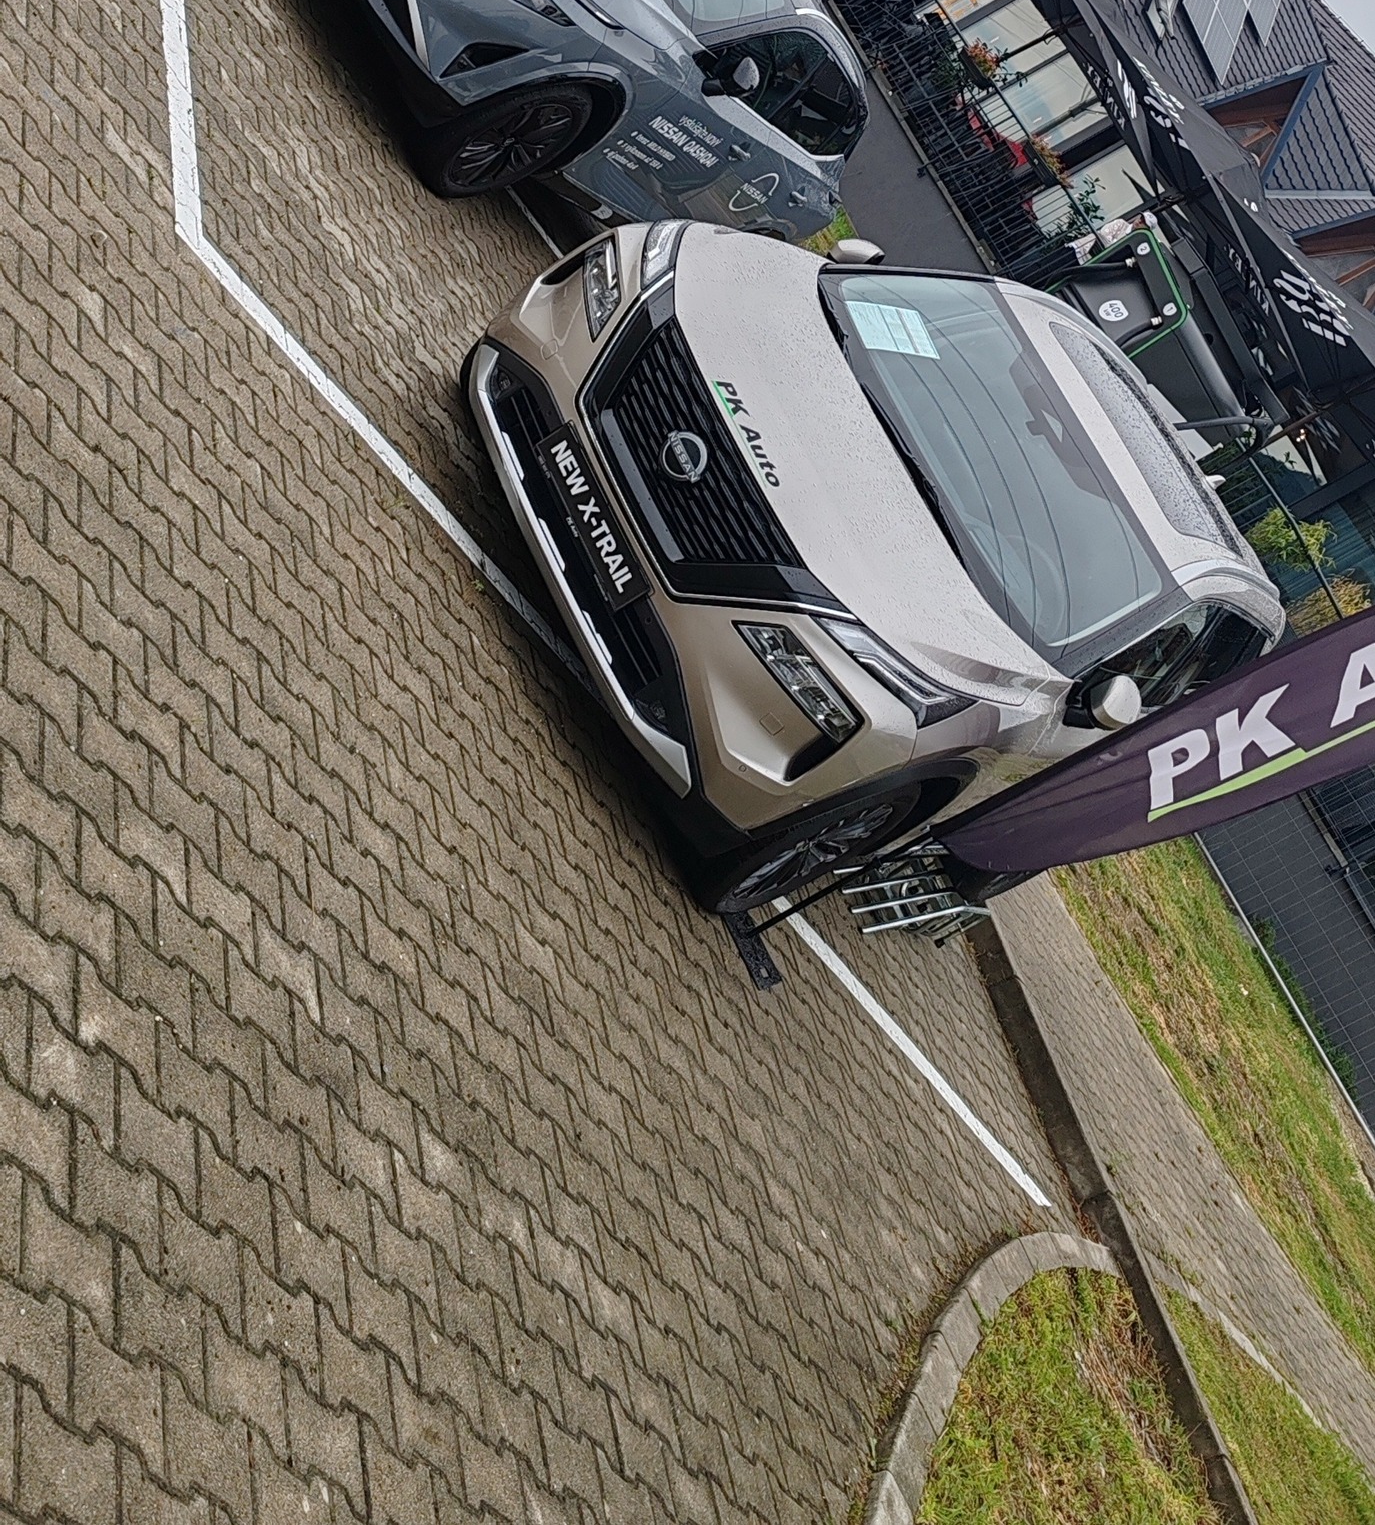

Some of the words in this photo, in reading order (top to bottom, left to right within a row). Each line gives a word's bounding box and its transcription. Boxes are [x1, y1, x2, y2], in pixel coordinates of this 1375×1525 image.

[647, 115, 691, 147] NISSAN
[680, 139, 719, 168] QASHQAI
[739, 182, 768, 204] NISSAN
[1108, 302, 1124, 318] 400
[666, 432, 697, 483] NISSAN
[715, 381, 750, 416] PK
[738, 424, 780, 486] Auto
[549, 439, 590, 496] NEW
[576, 495, 633, 593] X-TRAIL
[1147, 683, 1297, 810] PK
